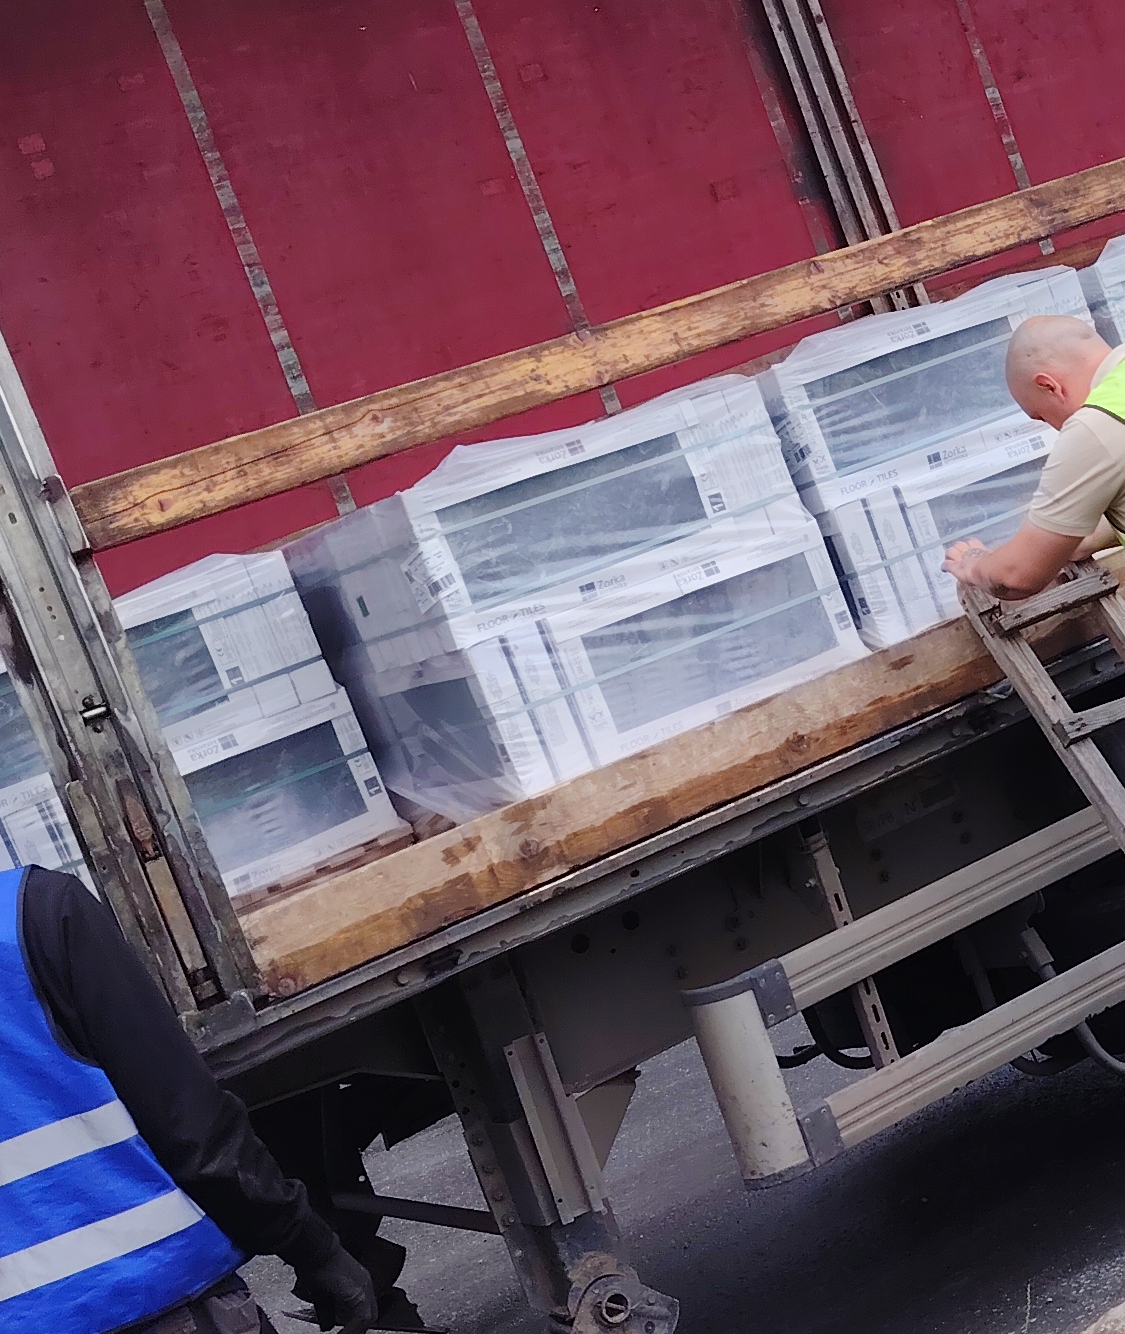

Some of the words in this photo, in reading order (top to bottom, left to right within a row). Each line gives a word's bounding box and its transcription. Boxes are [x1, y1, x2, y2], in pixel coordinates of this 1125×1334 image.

[942, 445, 968, 460] Zorka
[840, 481, 868, 496] FLOOR
[876, 468, 899, 484] TILES
[597, 573, 626, 590] Zorka
[477, 614, 509, 633] FLOOR
[518, 602, 546, 619] TILES
[190, 744, 219, 762] Zorka
